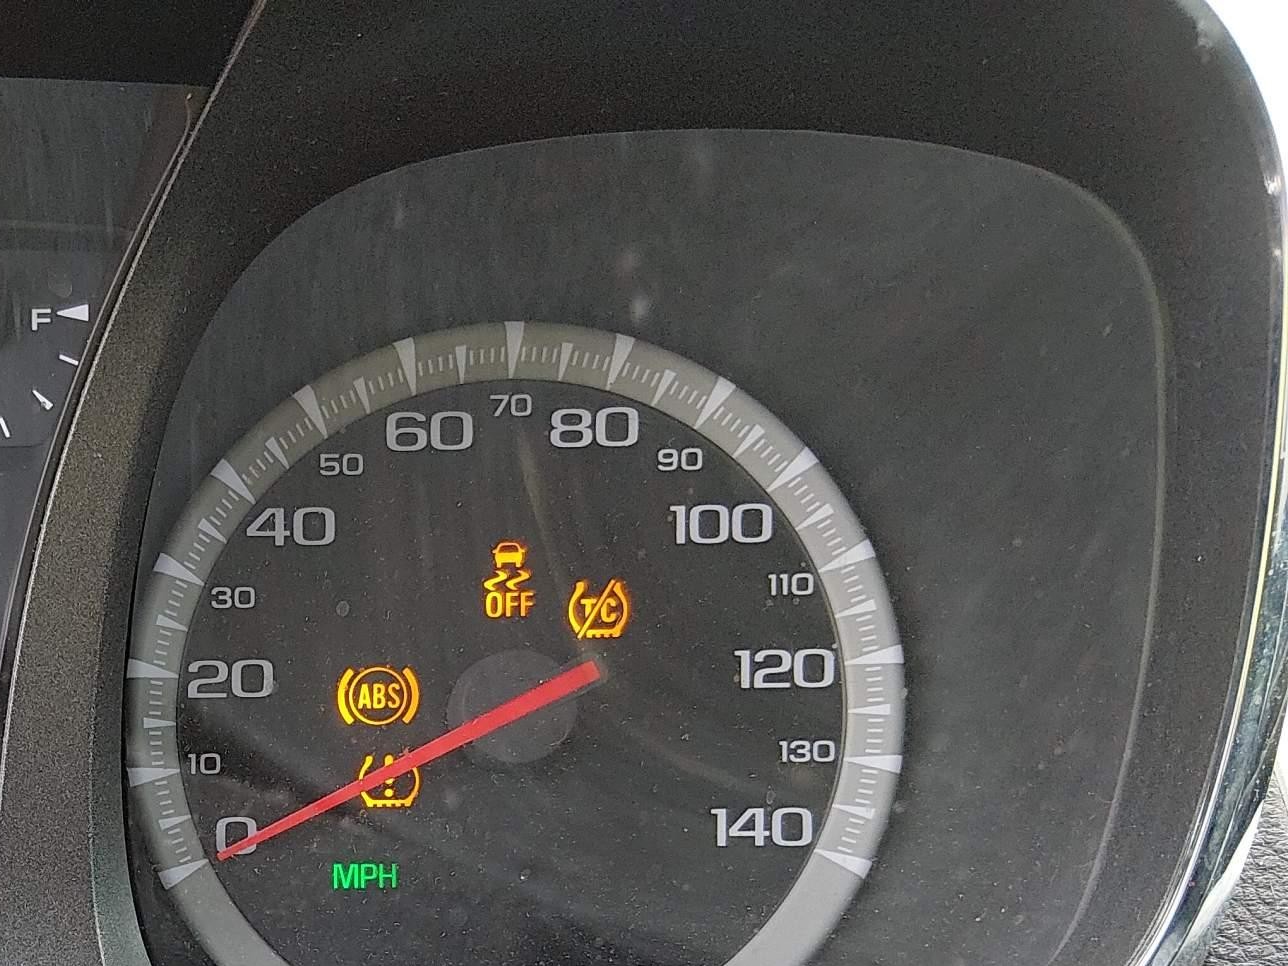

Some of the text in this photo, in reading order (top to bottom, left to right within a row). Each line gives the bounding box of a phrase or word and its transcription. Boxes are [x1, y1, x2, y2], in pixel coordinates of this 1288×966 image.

[32, 309, 51, 329] F
[491, 395, 532, 417] 70
[386, 412, 474, 451] 60
[550, 408, 640, 447] 80
[319, 454, 364, 476] 50
[657, 448, 703, 471] 90
[246, 507, 336, 546] 40
[669, 504, 773, 544] 100
[768, 573, 814, 596] 110
[211, 587, 256, 609] 30
[485, 592, 535, 618] OFF
[188, 660, 274, 698] 20
[734, 649, 834, 688] 120
[358, 681, 401, 709] ABS
[780, 741, 836, 762] 130
[188, 754, 221, 776] 10
[215, 816, 256, 855] 0
[710, 808, 811, 847] 140
[333, 863, 398, 889] MPH
